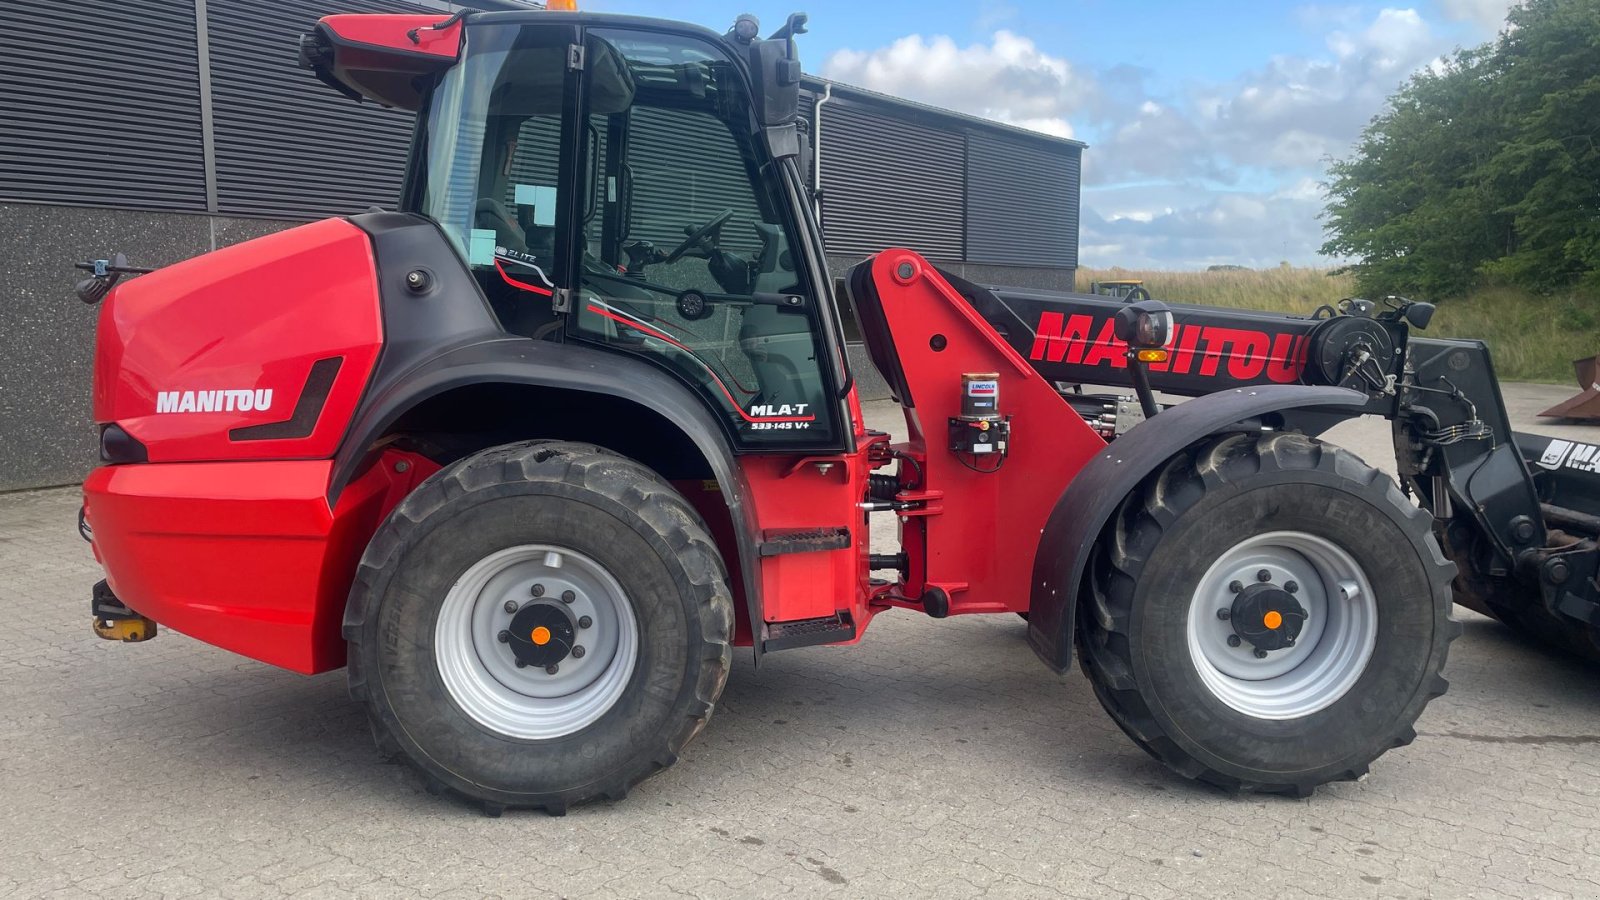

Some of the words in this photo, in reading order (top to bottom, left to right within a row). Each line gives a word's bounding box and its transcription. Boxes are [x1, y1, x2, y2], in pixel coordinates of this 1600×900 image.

[156, 388, 273, 414] MANITOU
[750, 403, 809, 417] MLA-T
[751, 421, 792, 431] 533-145
[795, 421, 810, 430] V+
